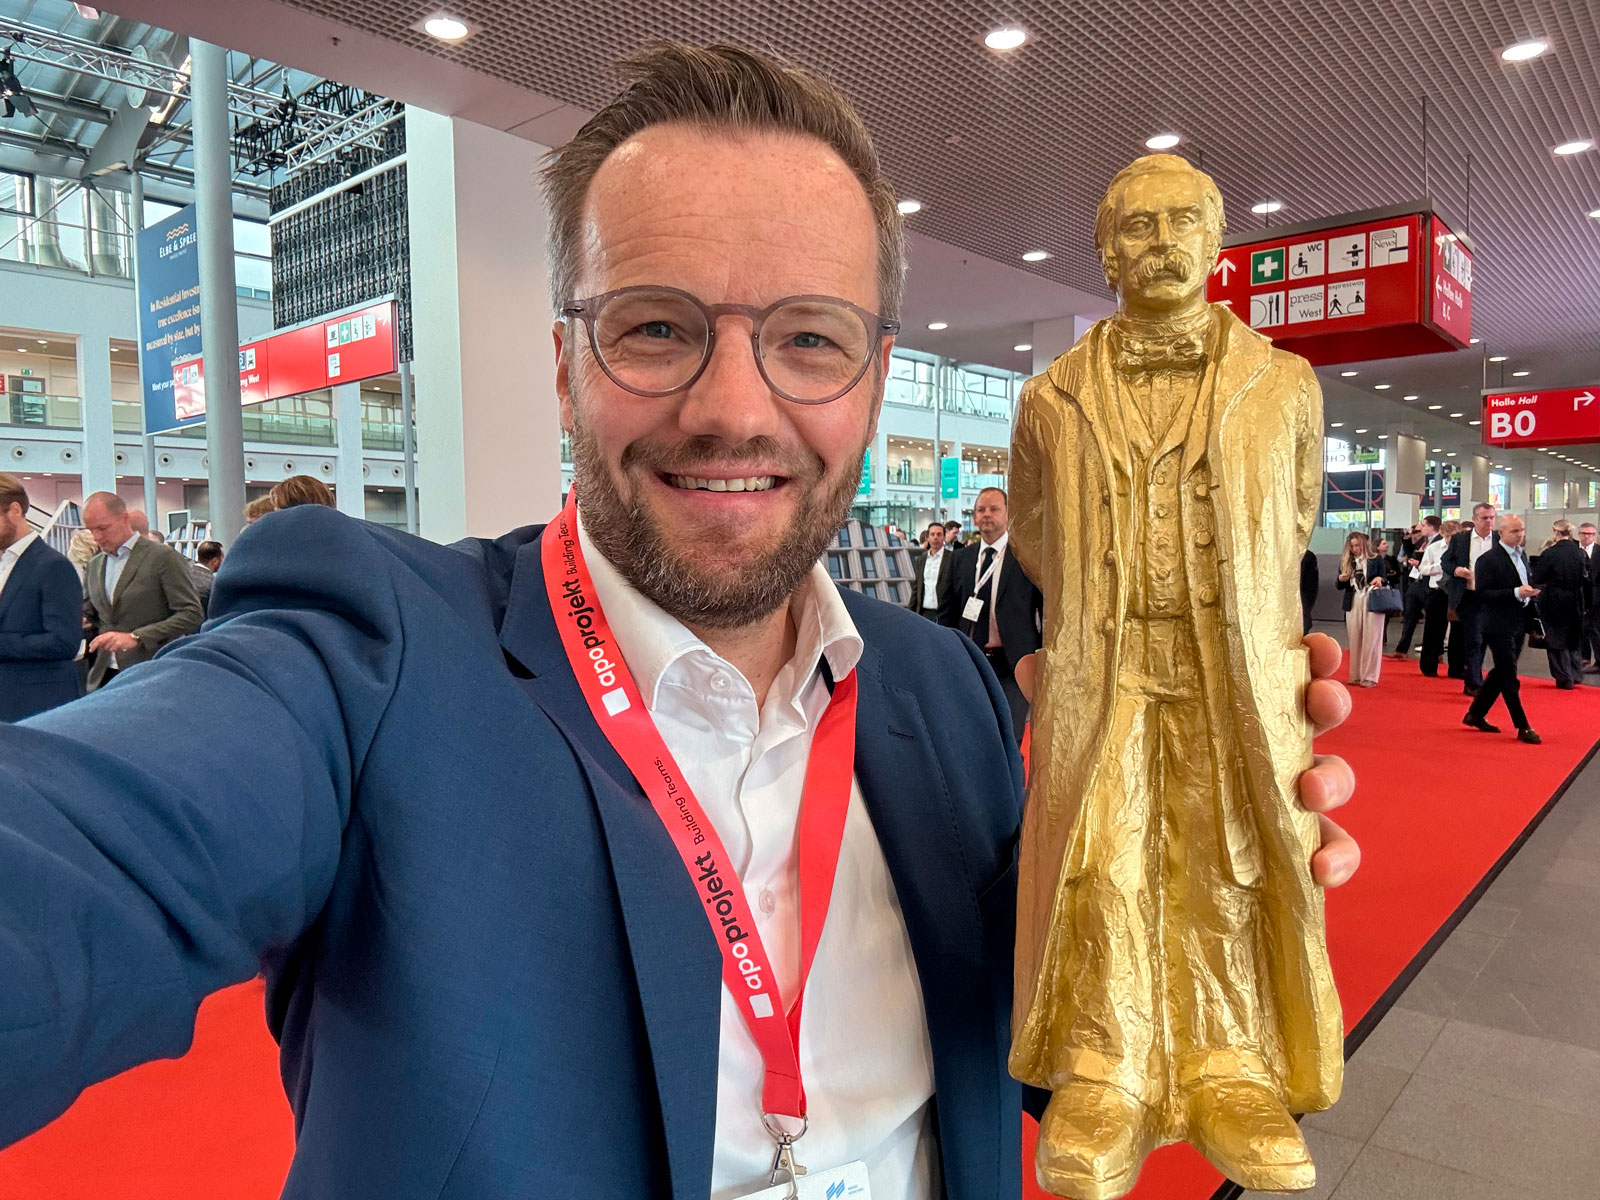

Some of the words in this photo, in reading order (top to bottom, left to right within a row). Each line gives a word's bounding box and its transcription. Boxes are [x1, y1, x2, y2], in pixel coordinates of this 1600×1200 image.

[159, 245, 172, 258] ELBE
[173, 240, 179, 251] &
[179, 232, 197, 248] SPREE
[1307, 243, 1323, 253] WC
[1374, 239, 1397, 250] News
[1327, 280, 1364, 291] expressway
[155, 290, 182, 309] Residential
[1289, 291, 1323, 308] press
[1298, 308, 1322, 319] West
[1491, 397, 1516, 408] Halle
[1518, 395, 1538, 405] Hall
[562, 539, 578, 576] Building
[562, 577, 616, 687] apoprojekt
[653, 756, 678, 799] Teams.
[675, 797, 706, 846] Building
[694, 850, 763, 990] apoprojekt
